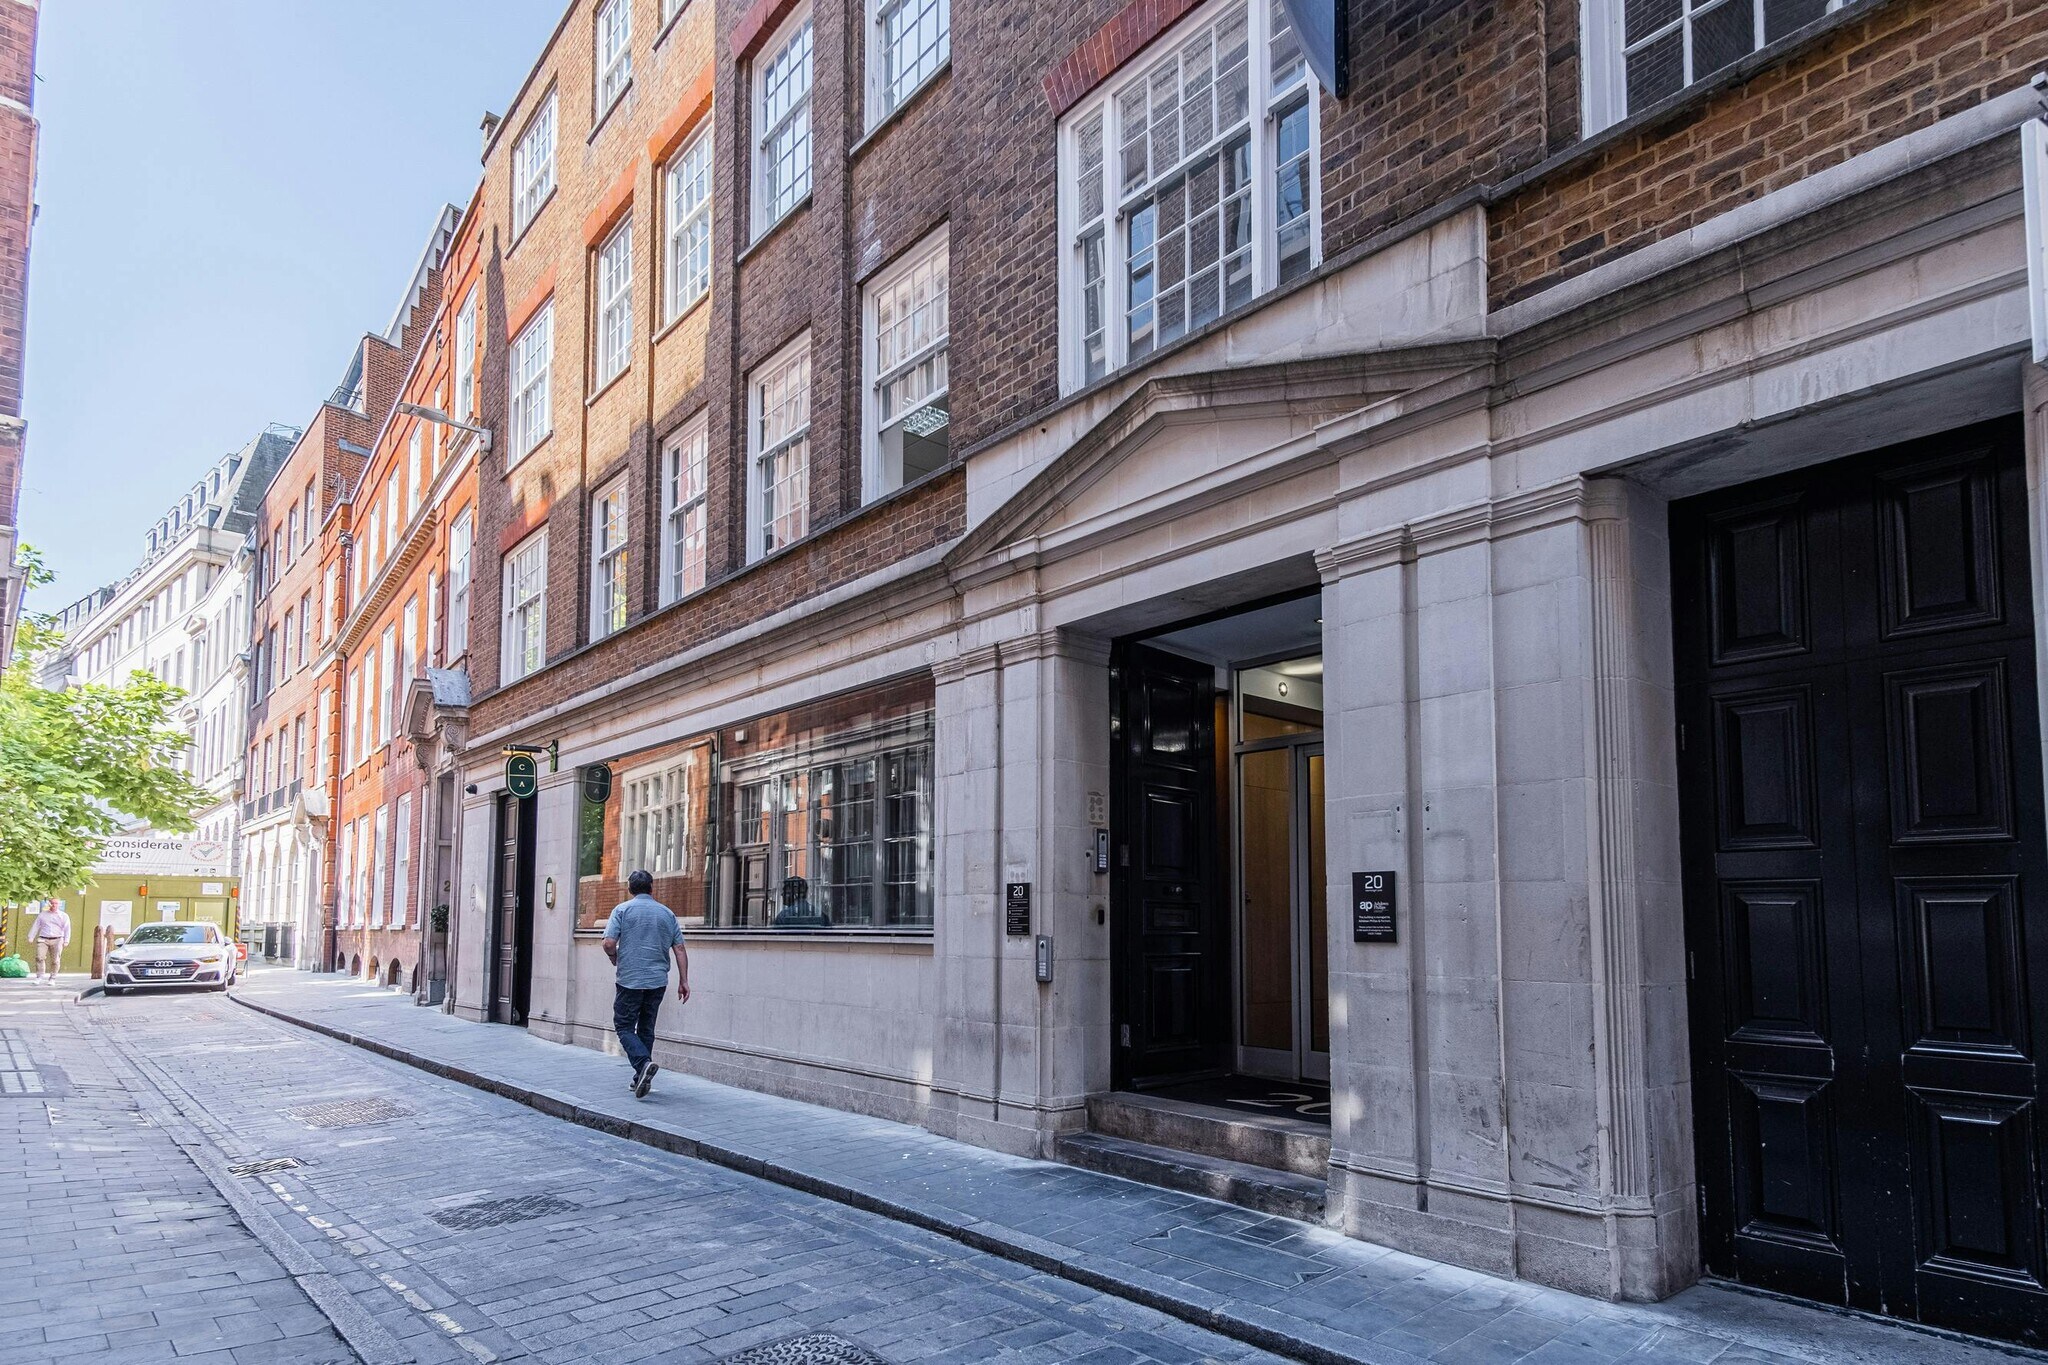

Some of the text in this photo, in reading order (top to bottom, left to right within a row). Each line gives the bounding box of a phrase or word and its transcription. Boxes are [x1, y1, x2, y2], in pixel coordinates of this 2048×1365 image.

[106, 839, 183, 851] considerate
[100, 850, 141, 858] uctors
[1364, 875, 1383, 889] 20
[1013, 886, 1024, 896] 20
[1359, 901, 1373, 912] ap
